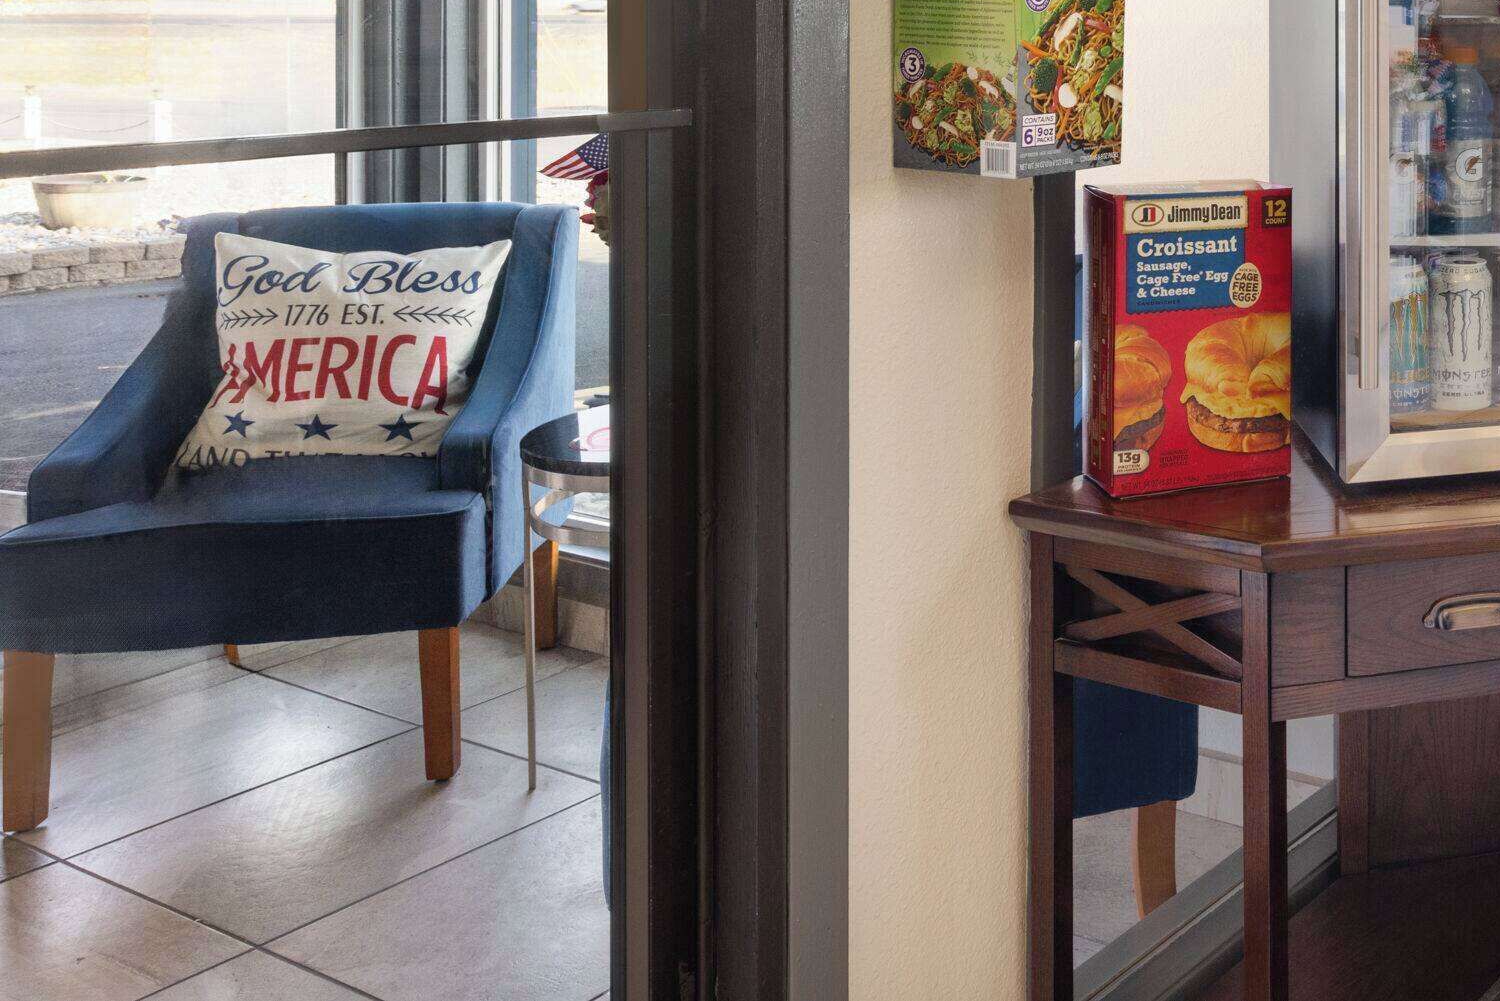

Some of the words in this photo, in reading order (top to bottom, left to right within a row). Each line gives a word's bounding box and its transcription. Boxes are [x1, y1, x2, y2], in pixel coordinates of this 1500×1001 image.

[1025, 116, 1054, 124] CONTAINS
[1024, 128, 1033, 145] 6
[1455, 147, 1484, 182] G
[1265, 199, 1287, 218] 12
[1137, 236, 1238, 257] Croissant
[1136, 261, 1192, 275] Sausage,
[218, 255, 332, 307] God
[343, 257, 484, 295] Bless
[1136, 273, 1169, 285] Cage
[1205, 270, 1228, 283] Egg
[1234, 272, 1259, 283] CAGE
[1136, 287, 1148, 299] &
[1150, 286, 1196, 298] Cheese
[1232, 281, 1259, 293] FREE
[1232, 291, 1257, 302] EGGS
[285, 304, 329, 326] 1776
[341, 303, 385, 325] EST.
[208, 334, 449, 417] AMERICA
[1432, 367, 1491, 382] MONSTER
[1117, 452, 1141, 464] 13g
